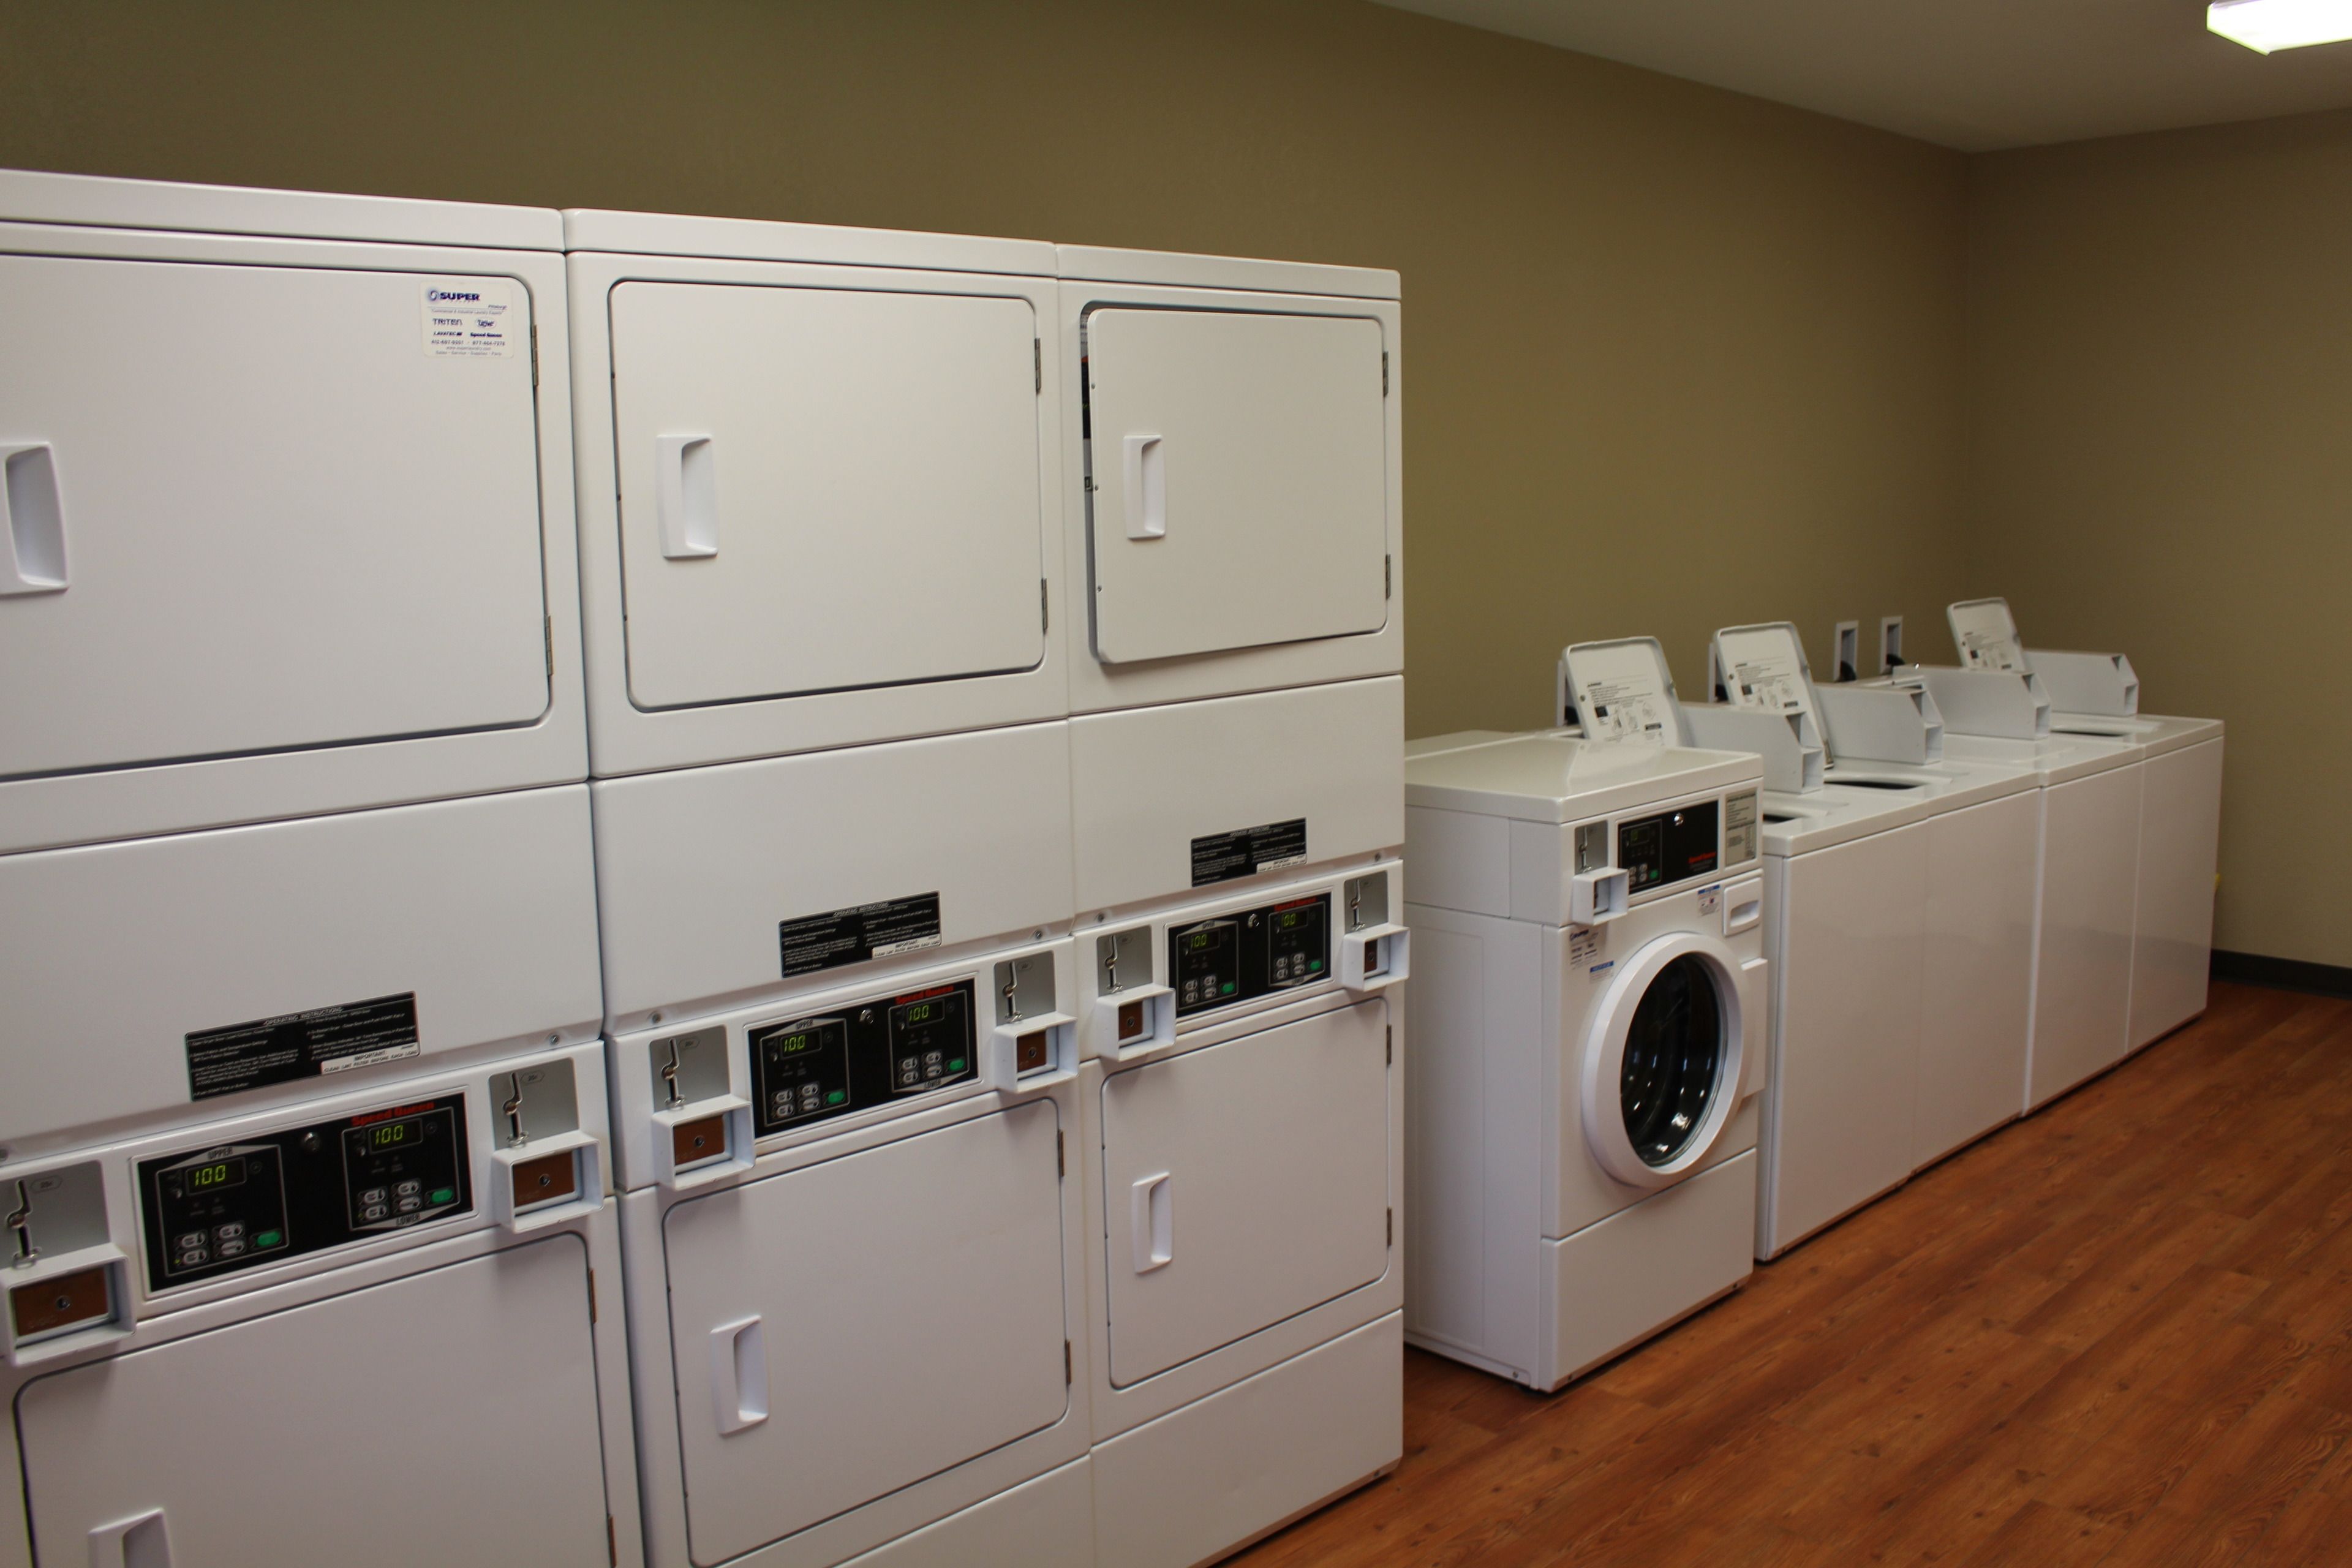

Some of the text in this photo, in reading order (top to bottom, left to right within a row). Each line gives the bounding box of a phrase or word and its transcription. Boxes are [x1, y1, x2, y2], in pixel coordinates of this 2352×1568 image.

[440, 292, 480, 301] SUPER
[265, 1014, 299, 1025] OPERATING
[301, 1007, 344, 1019] INSTRUCTIONS
[909, 1005, 929, 1021] 100
[796, 1019, 813, 1030] UPPER
[784, 1035, 805, 1052] 100
[352, 1101, 435, 1127] Speed Queen
[375, 1125, 404, 1144] 100
[208, 1146, 233, 1159] UPPER
[194, 1164, 226, 1186] 100
[396, 1213, 421, 1227] LOWER
